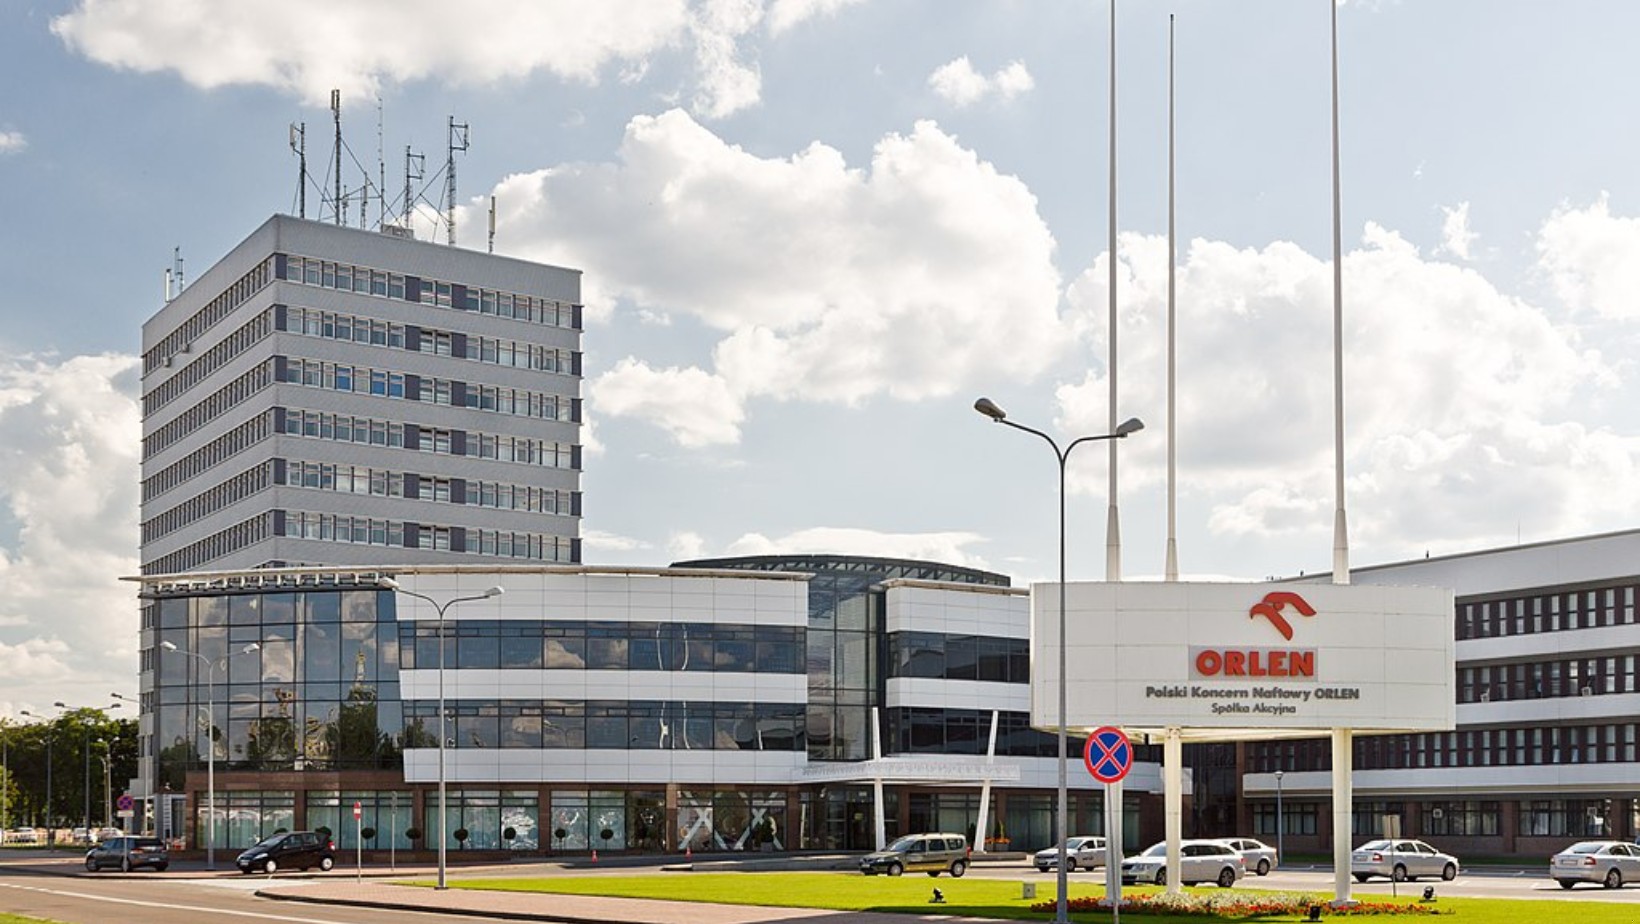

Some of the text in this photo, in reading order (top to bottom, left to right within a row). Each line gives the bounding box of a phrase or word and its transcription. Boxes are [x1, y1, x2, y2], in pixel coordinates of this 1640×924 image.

[1195, 650, 1314, 677] ORLEN
[1146, 686, 1359, 702] Polski Koncern Naftowy ORLEN
[1211, 702, 1296, 715] Spółka Akcyjna
